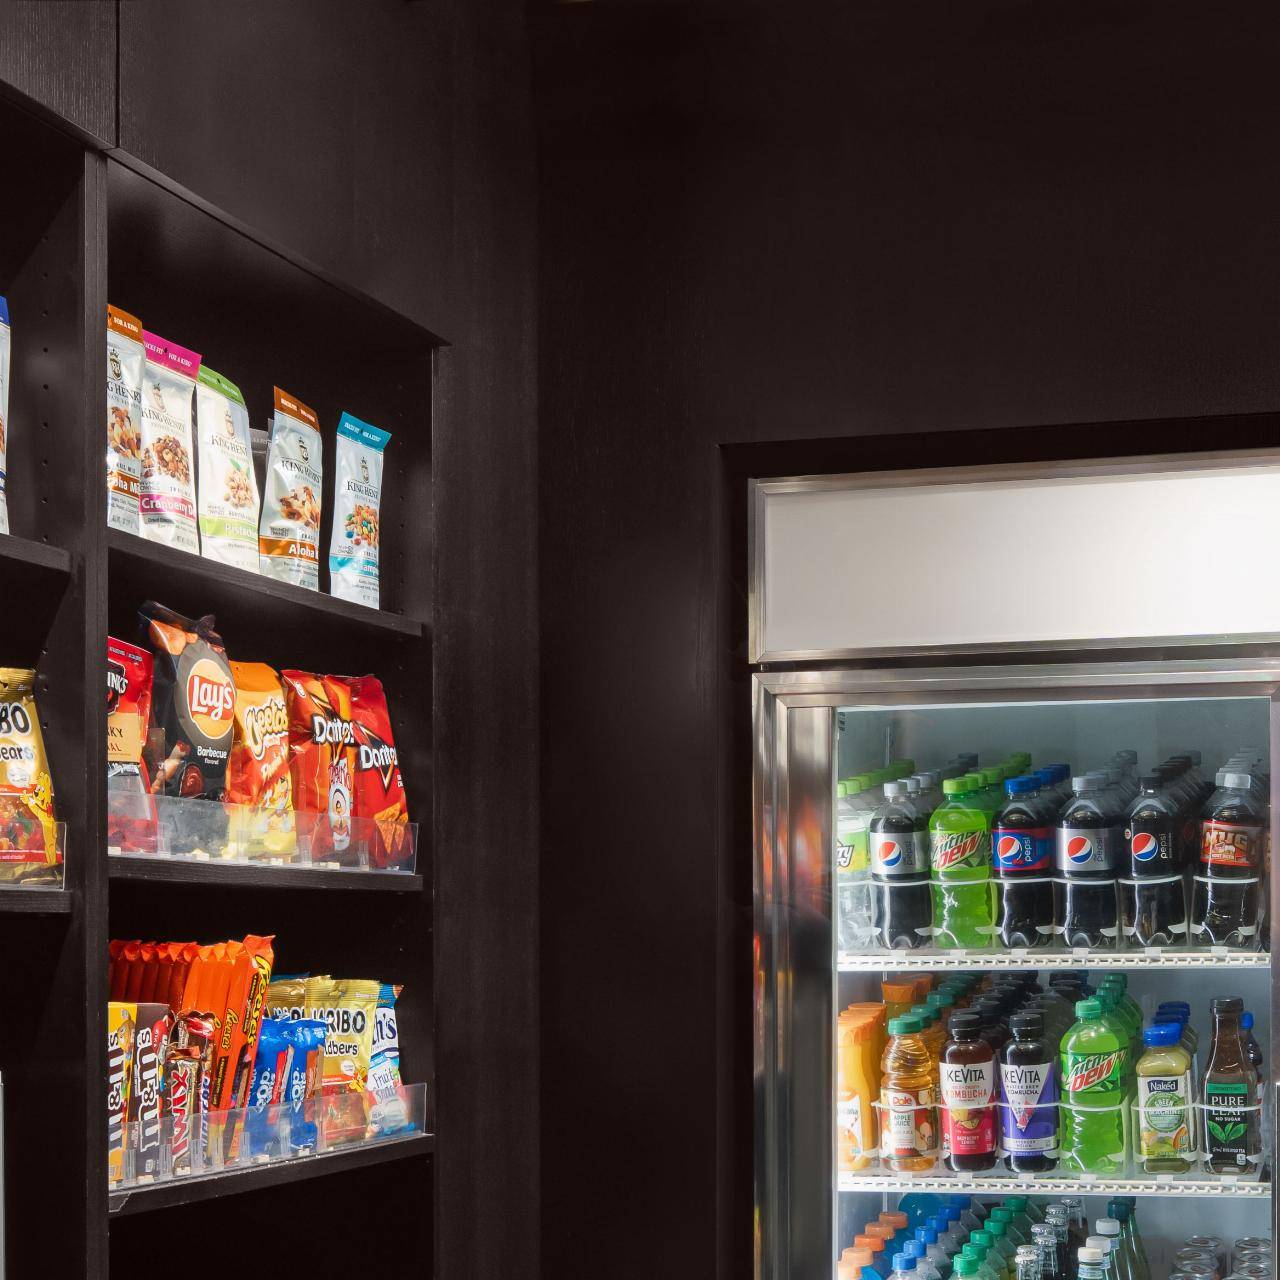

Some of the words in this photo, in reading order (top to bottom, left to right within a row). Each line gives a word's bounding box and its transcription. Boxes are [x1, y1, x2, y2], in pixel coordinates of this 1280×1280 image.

[192, 676, 233, 720] Lay's
[196, 745, 228, 760] Barbecue
[1023, 837, 1033, 862] pepsi
[1159, 832, 1169, 859] pepsi
[223, 1008, 238, 1050] Reese's
[1150, 1081, 1177, 1093] Naked
[892, 1096, 913, 1106] Dole
[1211, 1096, 1245, 1106] PURE
